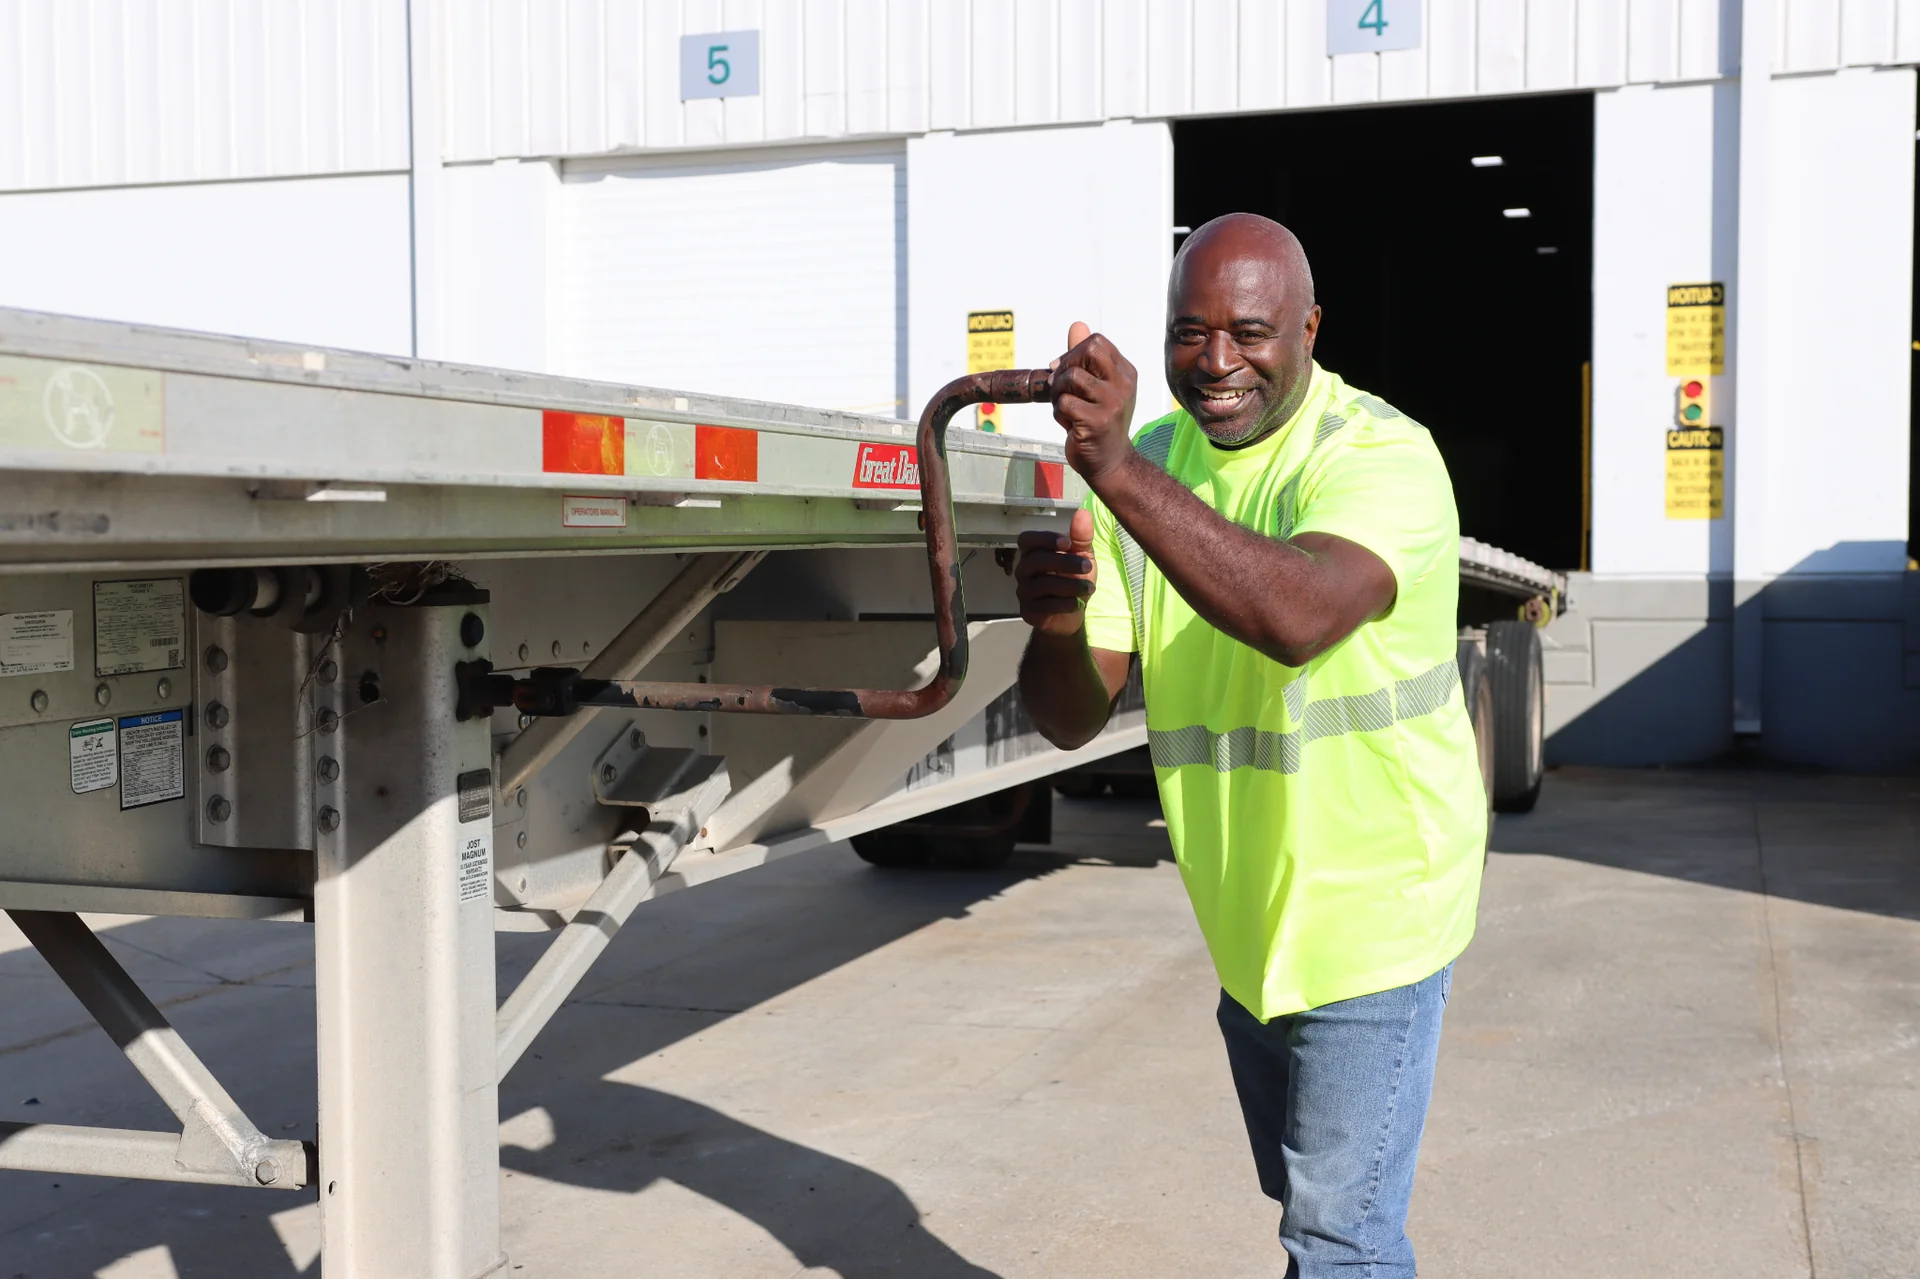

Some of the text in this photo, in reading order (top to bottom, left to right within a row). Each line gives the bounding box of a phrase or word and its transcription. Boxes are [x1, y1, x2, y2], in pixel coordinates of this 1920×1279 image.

[1358, 0, 1389, 36] 4
[707, 44, 731, 85] 5
[1668, 430, 1722, 448] CAUTION
[860, 447, 921, 486] Great Dan
[571, 507, 620, 517] OPERATORS MANUAL
[141, 714, 162, 724] NOTICE
[467, 838, 481, 850] JOST
[461, 847, 486, 861] MAGNUM
